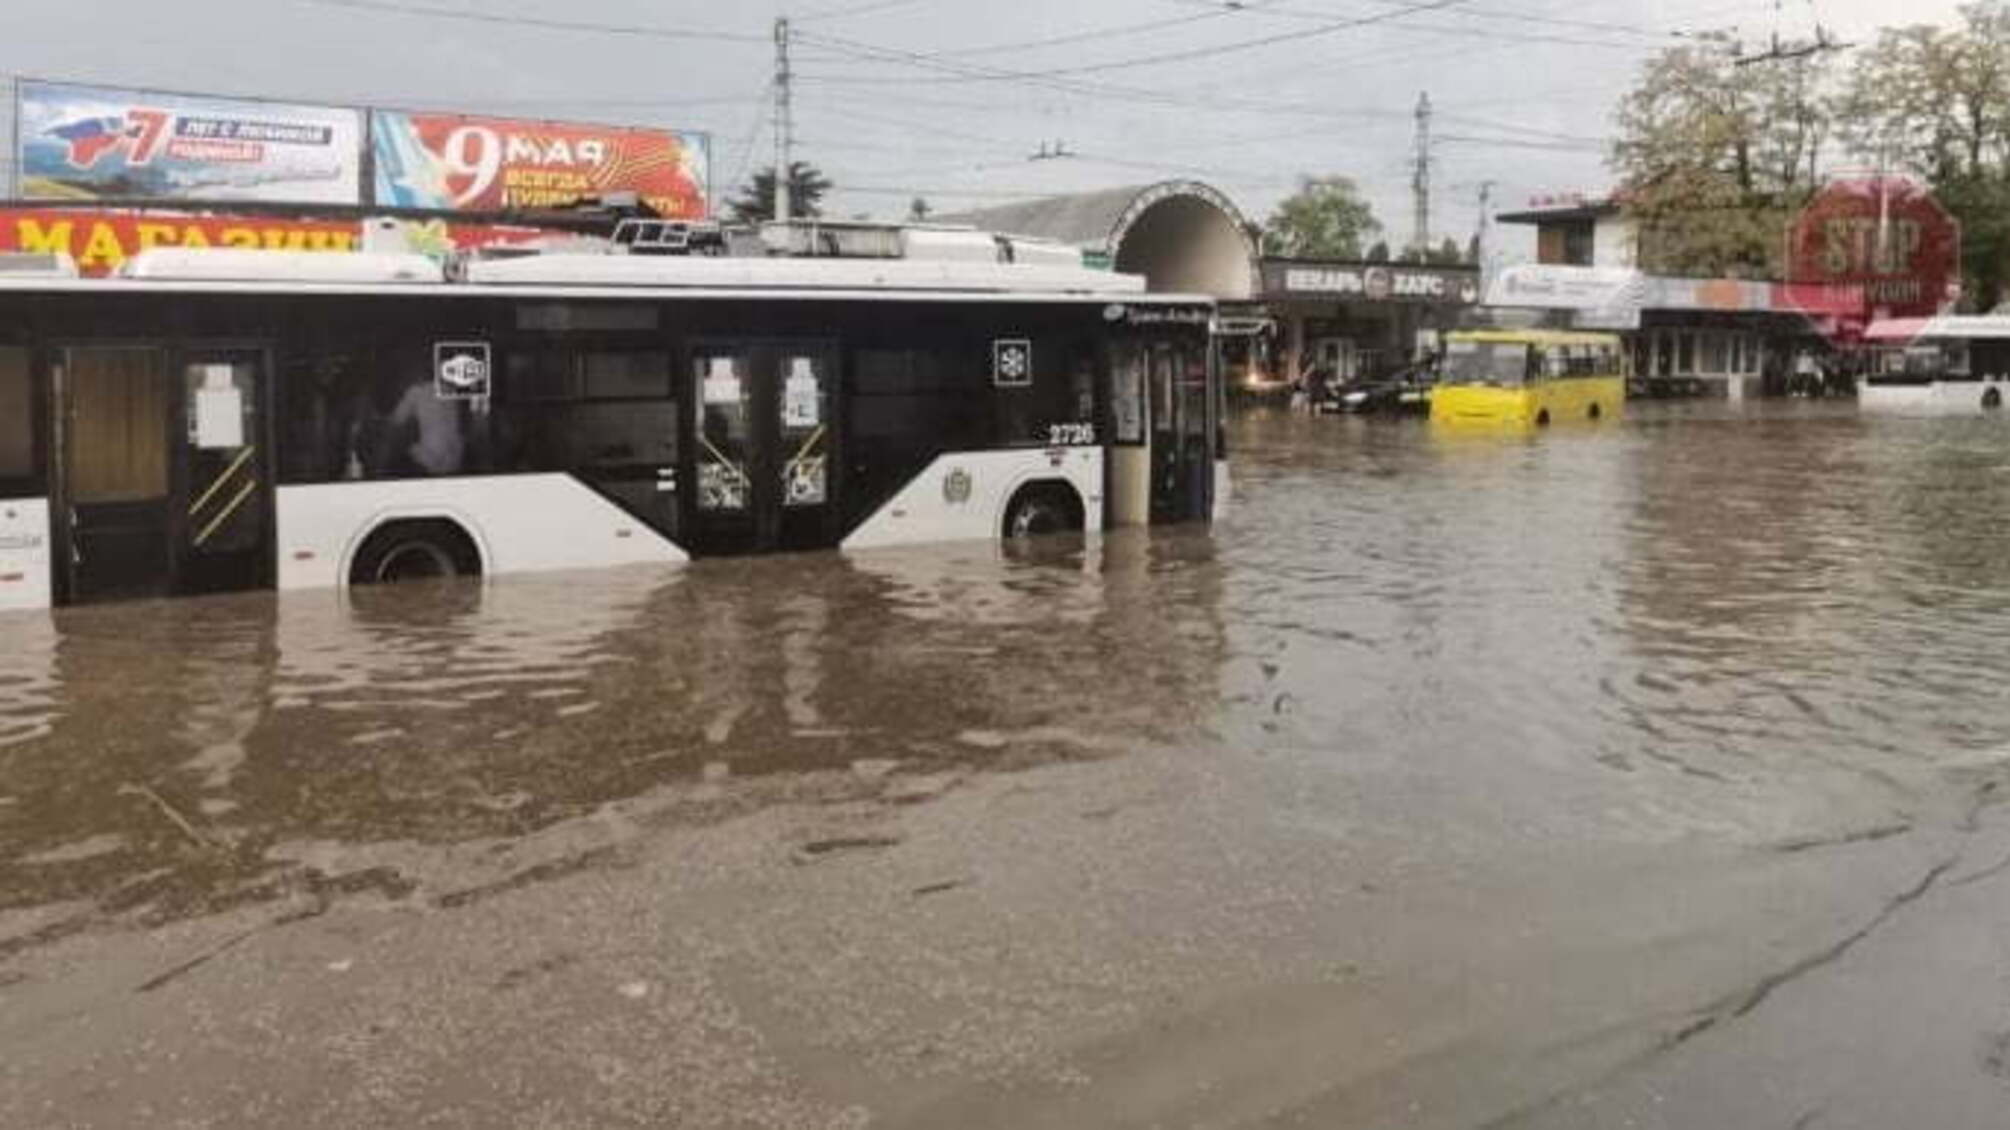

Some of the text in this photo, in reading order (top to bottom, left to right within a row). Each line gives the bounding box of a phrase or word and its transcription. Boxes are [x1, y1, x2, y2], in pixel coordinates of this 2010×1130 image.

[127, 109, 169, 163] 7
[445, 126, 605, 207] 9 МАЯ
